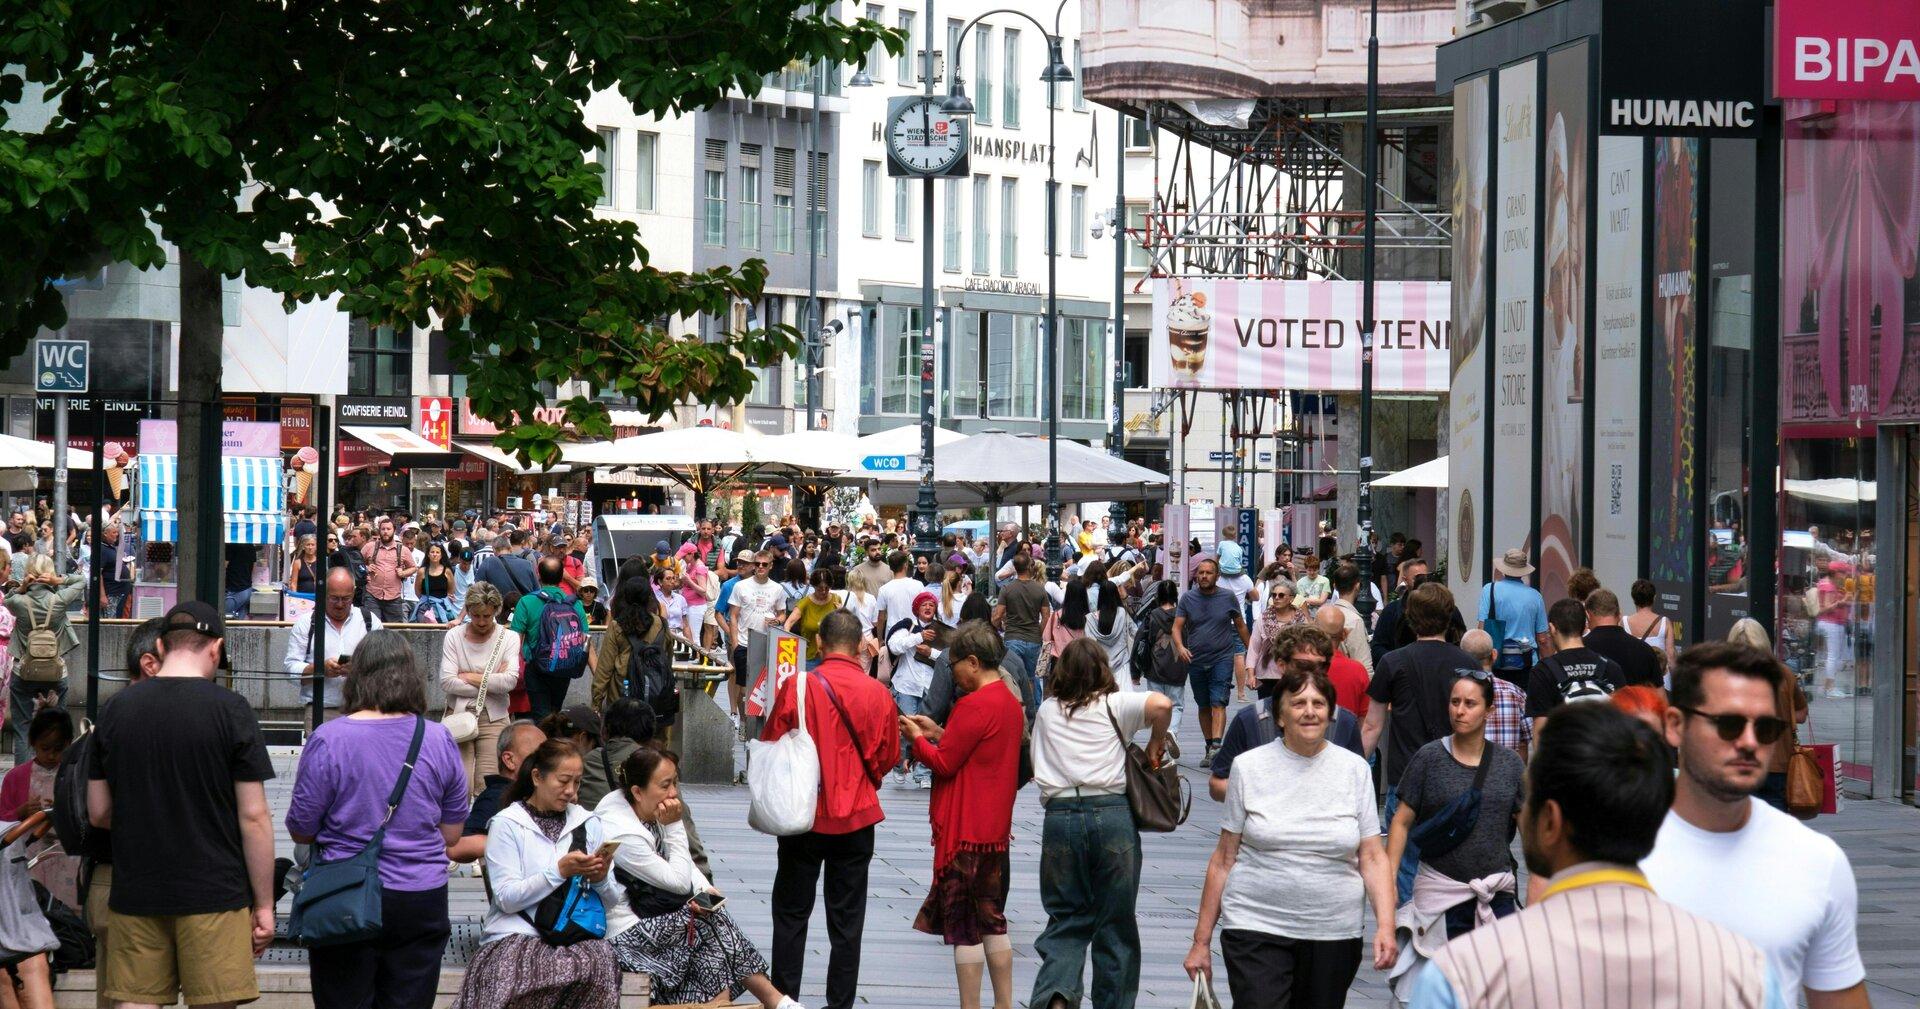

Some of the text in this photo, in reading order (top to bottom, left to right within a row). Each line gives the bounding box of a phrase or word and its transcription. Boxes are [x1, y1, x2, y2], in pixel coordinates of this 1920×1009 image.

[1795, 36, 1920, 83] BIPA
[1611, 99, 1755, 128] HUMANIC
[1506, 193, 1527, 219] GRAND
[1503, 226, 1529, 253] OPENING
[1658, 270, 1692, 298] HUMANIC
[1503, 300, 1527, 333] LINDT
[1233, 318, 1344, 349] VOTED
[42, 345, 84, 368] WC
[1501, 374, 1527, 406] STORE
[1850, 384, 1869, 412] BIPA
[281, 417, 310, 427] HEINDL
[341, 404, 408, 418] CONFISERIE HEINDL
[873, 457, 890, 468] WC
